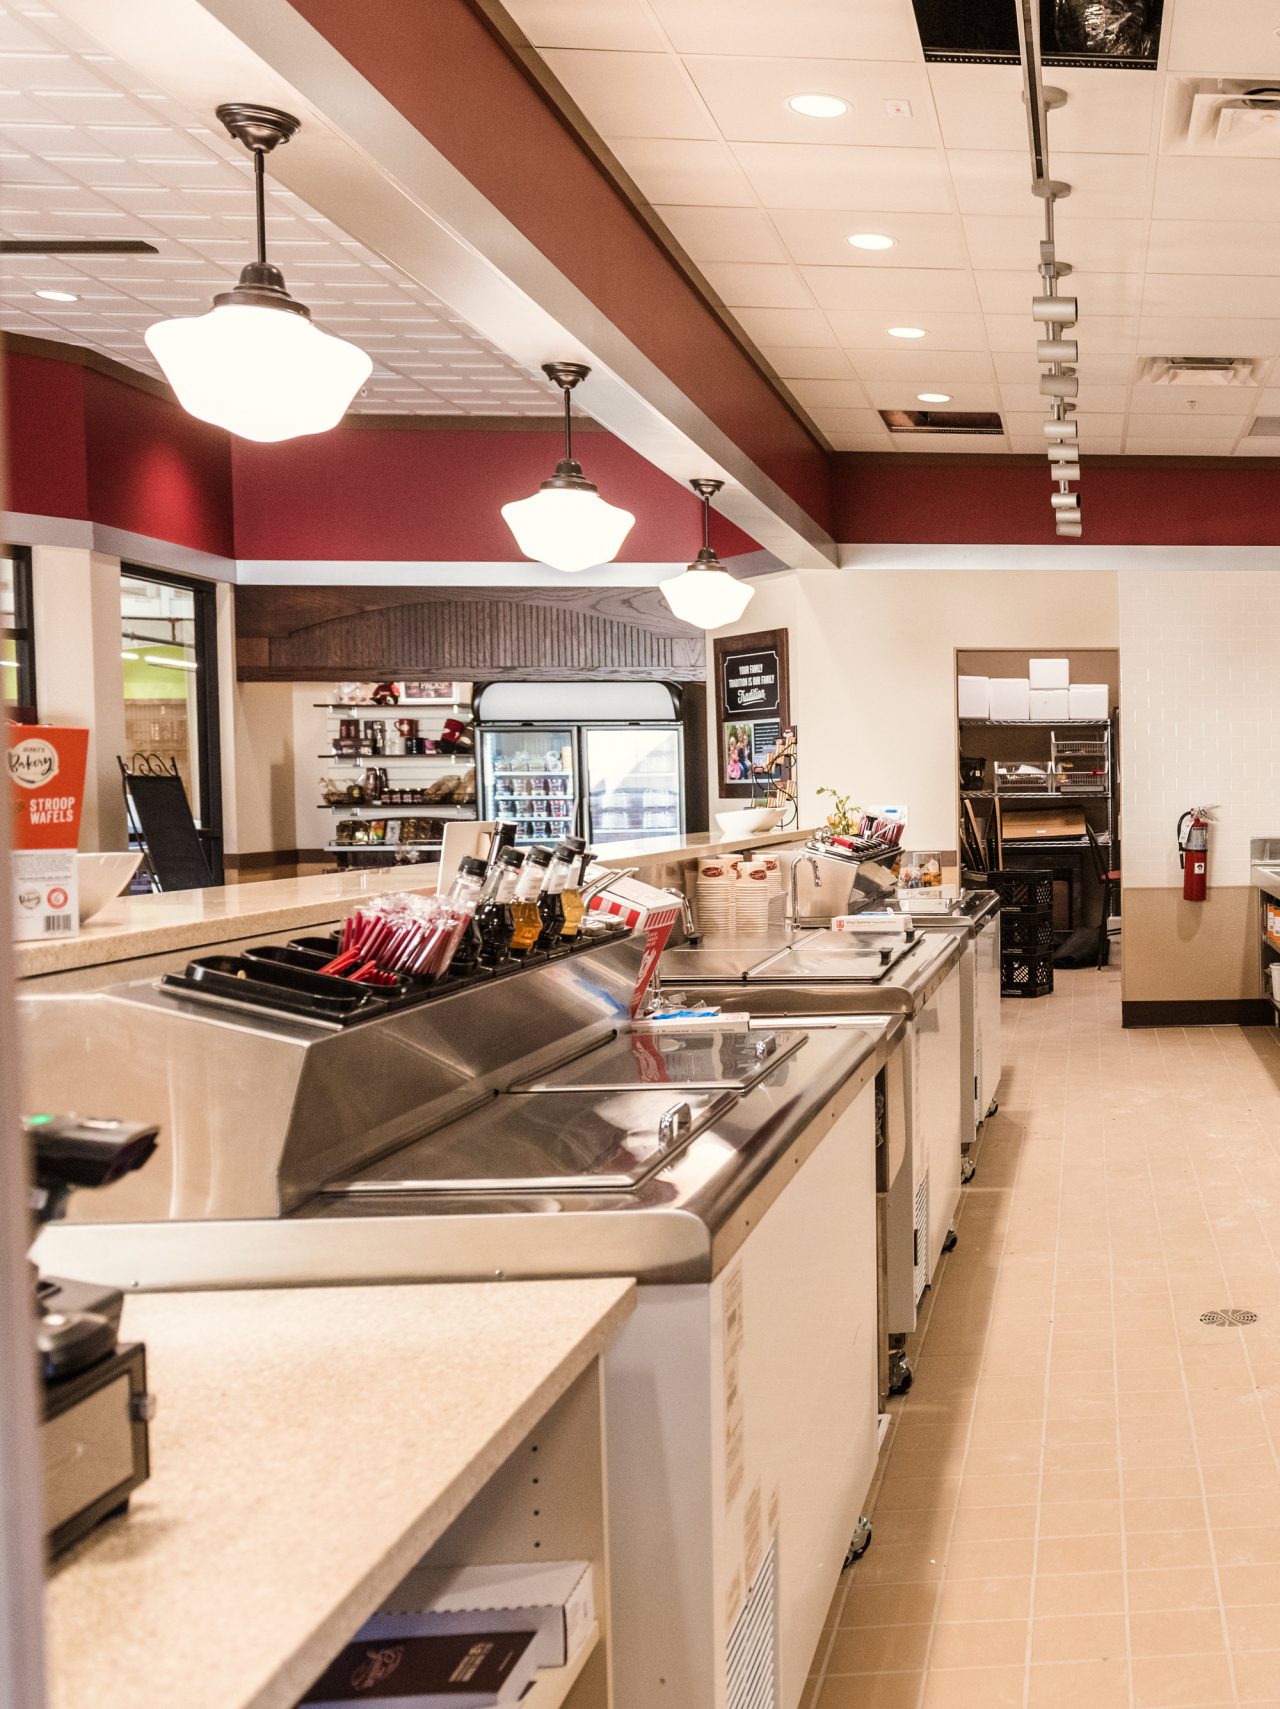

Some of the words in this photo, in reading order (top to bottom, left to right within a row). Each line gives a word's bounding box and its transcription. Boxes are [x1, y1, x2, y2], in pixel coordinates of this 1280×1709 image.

[750, 664, 763, 673] FAMILY
[761, 675, 774, 684] FAMILY
[29, 796, 76, 812] STROOP
[30, 809, 74, 825] WAFELS
